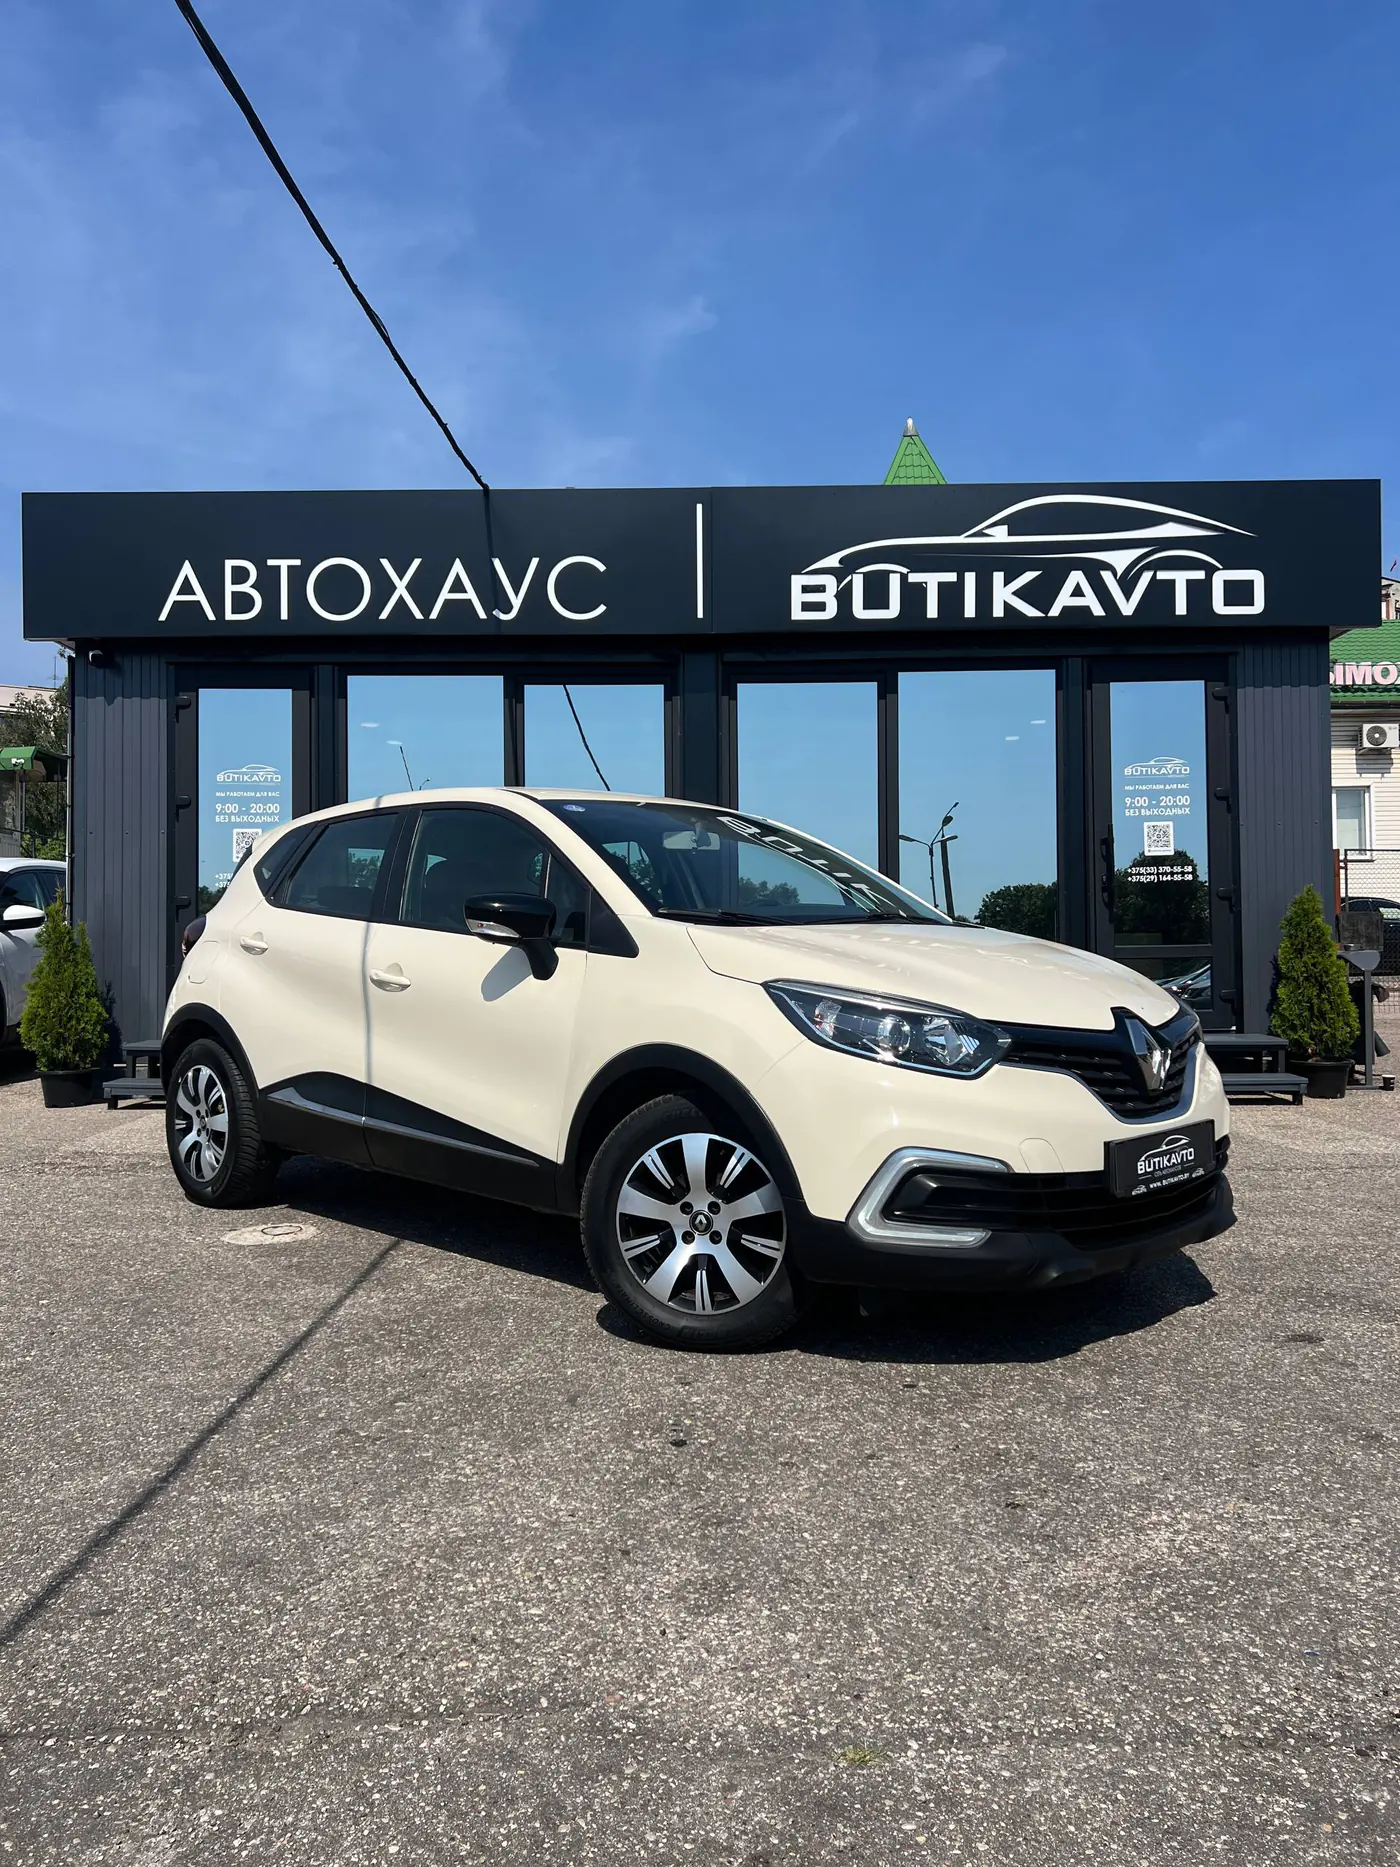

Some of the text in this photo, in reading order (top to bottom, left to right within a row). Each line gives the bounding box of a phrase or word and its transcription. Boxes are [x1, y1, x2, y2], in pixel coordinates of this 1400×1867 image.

[158, 555, 608, 622] АВТОХАУС
[790, 568, 1265, 622] BUTIKAVTO
[1124, 766, 1190, 776] BUTIKAVTO
[216, 774, 281, 782] BUTIKAVTO
[1125, 797, 1148, 807] 9:00
[1160, 795, 1190, 806] 20:00
[216, 803, 238, 813] 9:00
[250, 803, 280, 813] 20:00
[1125, 807, 1190, 816] БЕЗ ВЫХОДНЫХ
[216, 815, 280, 823] БЕЗ ВЫХОДНЫХ
[1127, 865, 1193, 875] +375(33) 370-55-58
[1127, 874, 1193, 883] +375(29) 164-55-58
[1137, 1148, 1195, 1175] BUTIKAVTO
